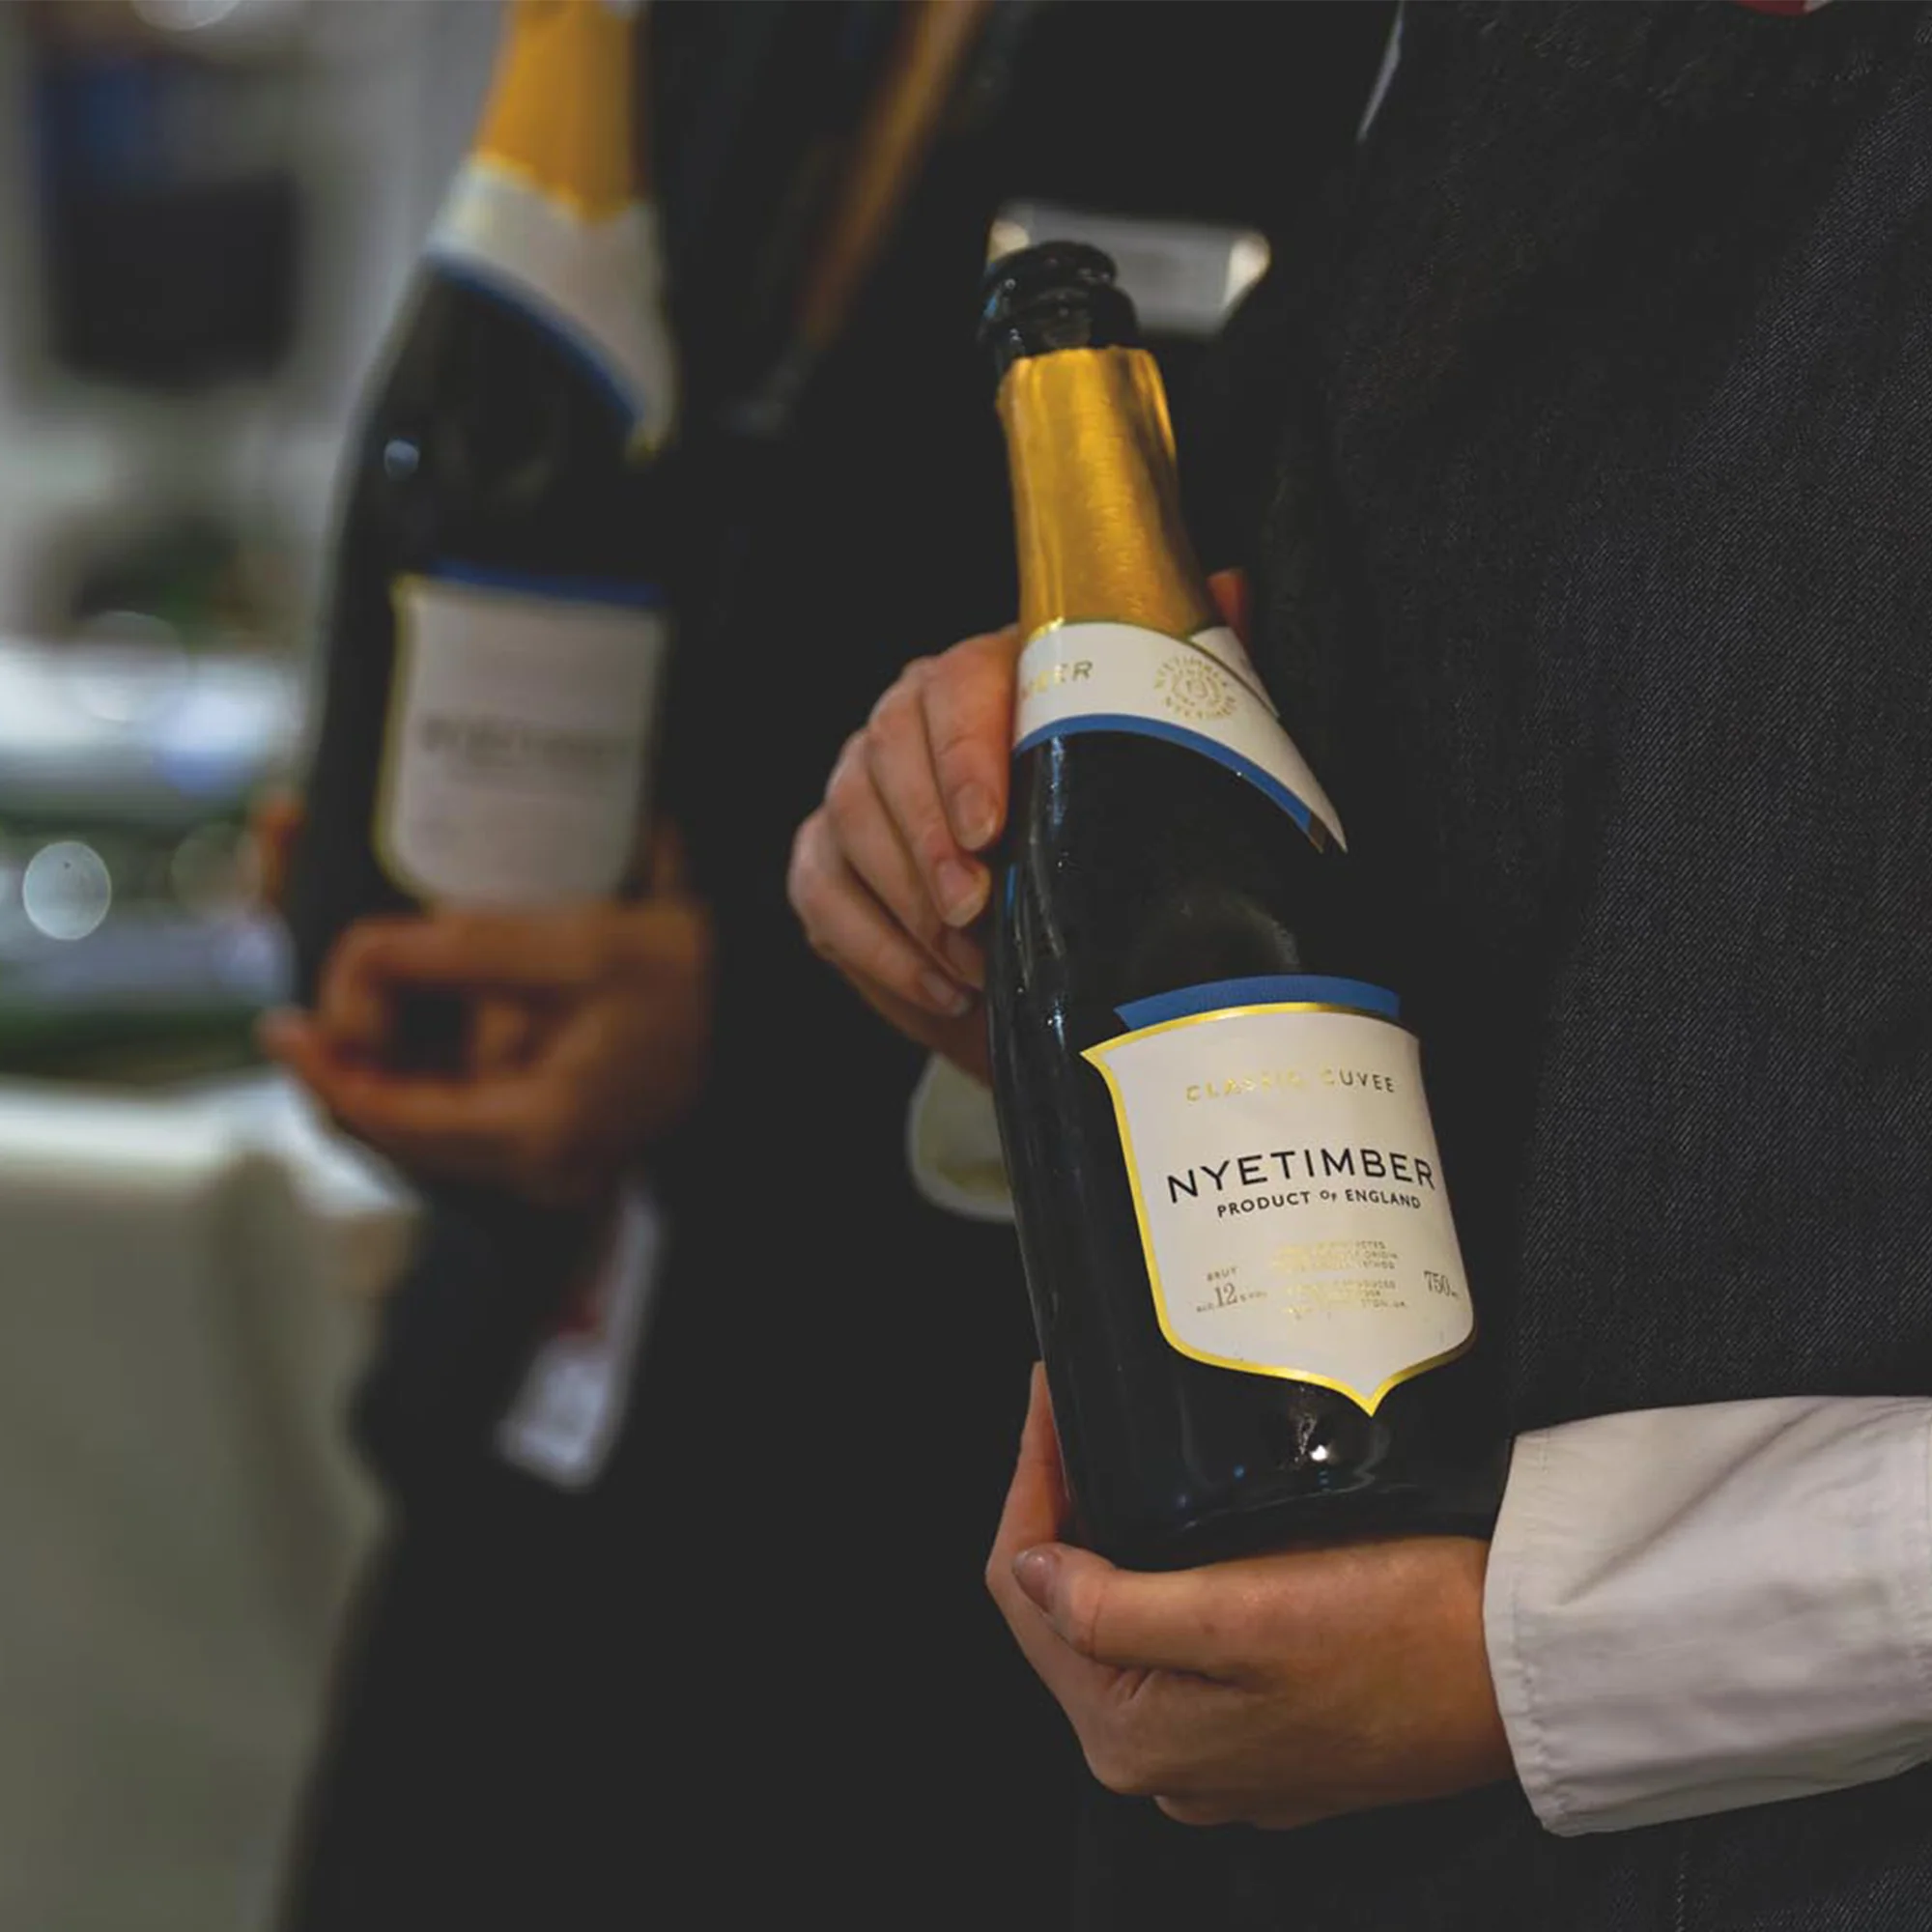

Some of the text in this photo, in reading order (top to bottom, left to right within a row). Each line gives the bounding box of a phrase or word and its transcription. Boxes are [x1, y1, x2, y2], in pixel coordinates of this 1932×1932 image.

[1320, 1068, 1395, 1094] CUVEE
[1167, 1148, 1435, 1204] NYETIMBER
[1217, 1191, 1310, 1218] PRODUCT
[1346, 1189, 1421, 1209] ENGLAND
[1215, 1282, 1238, 1307] 12
